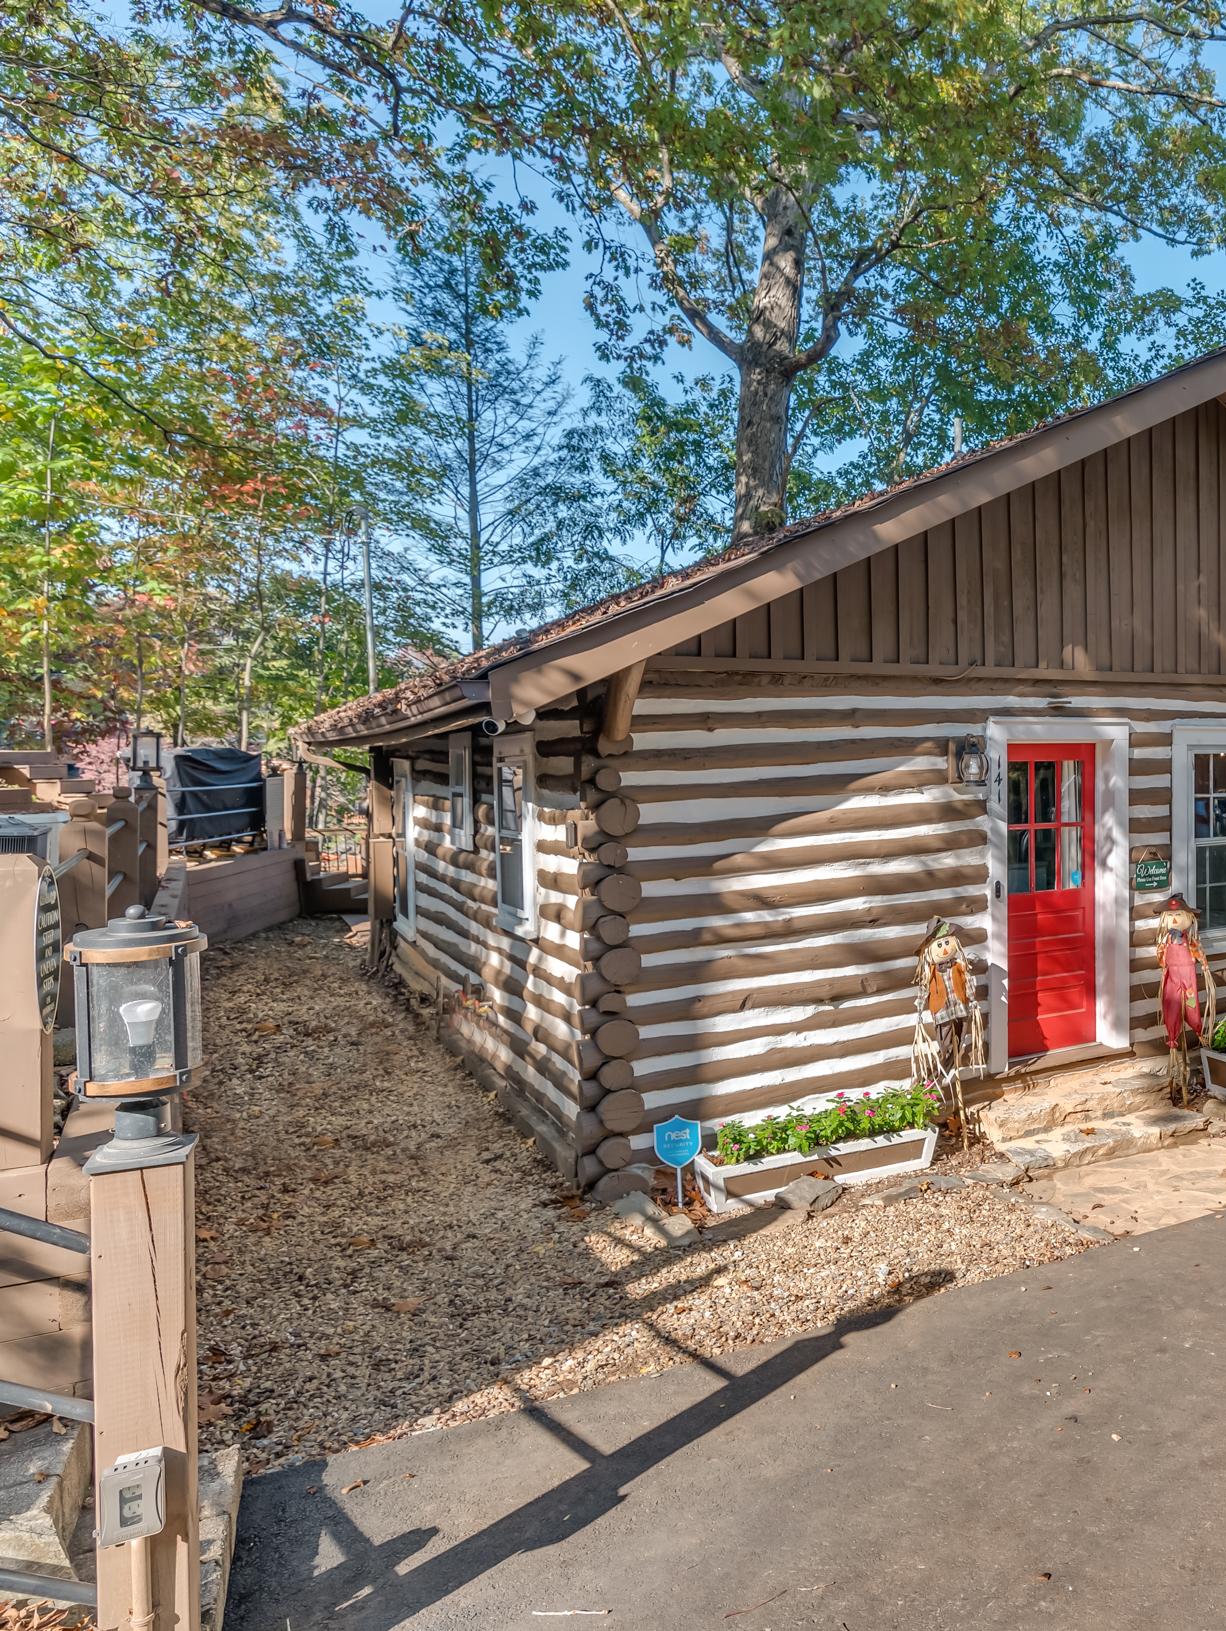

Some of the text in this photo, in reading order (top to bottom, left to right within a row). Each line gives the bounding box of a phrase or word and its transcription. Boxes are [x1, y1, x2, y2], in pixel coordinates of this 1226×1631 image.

[993, 754, 1003, 804] 141
[1136, 864, 1167, 877] Welcome
[38, 909, 59, 930] CAUTION
[665, 1128, 690, 1141] nest
